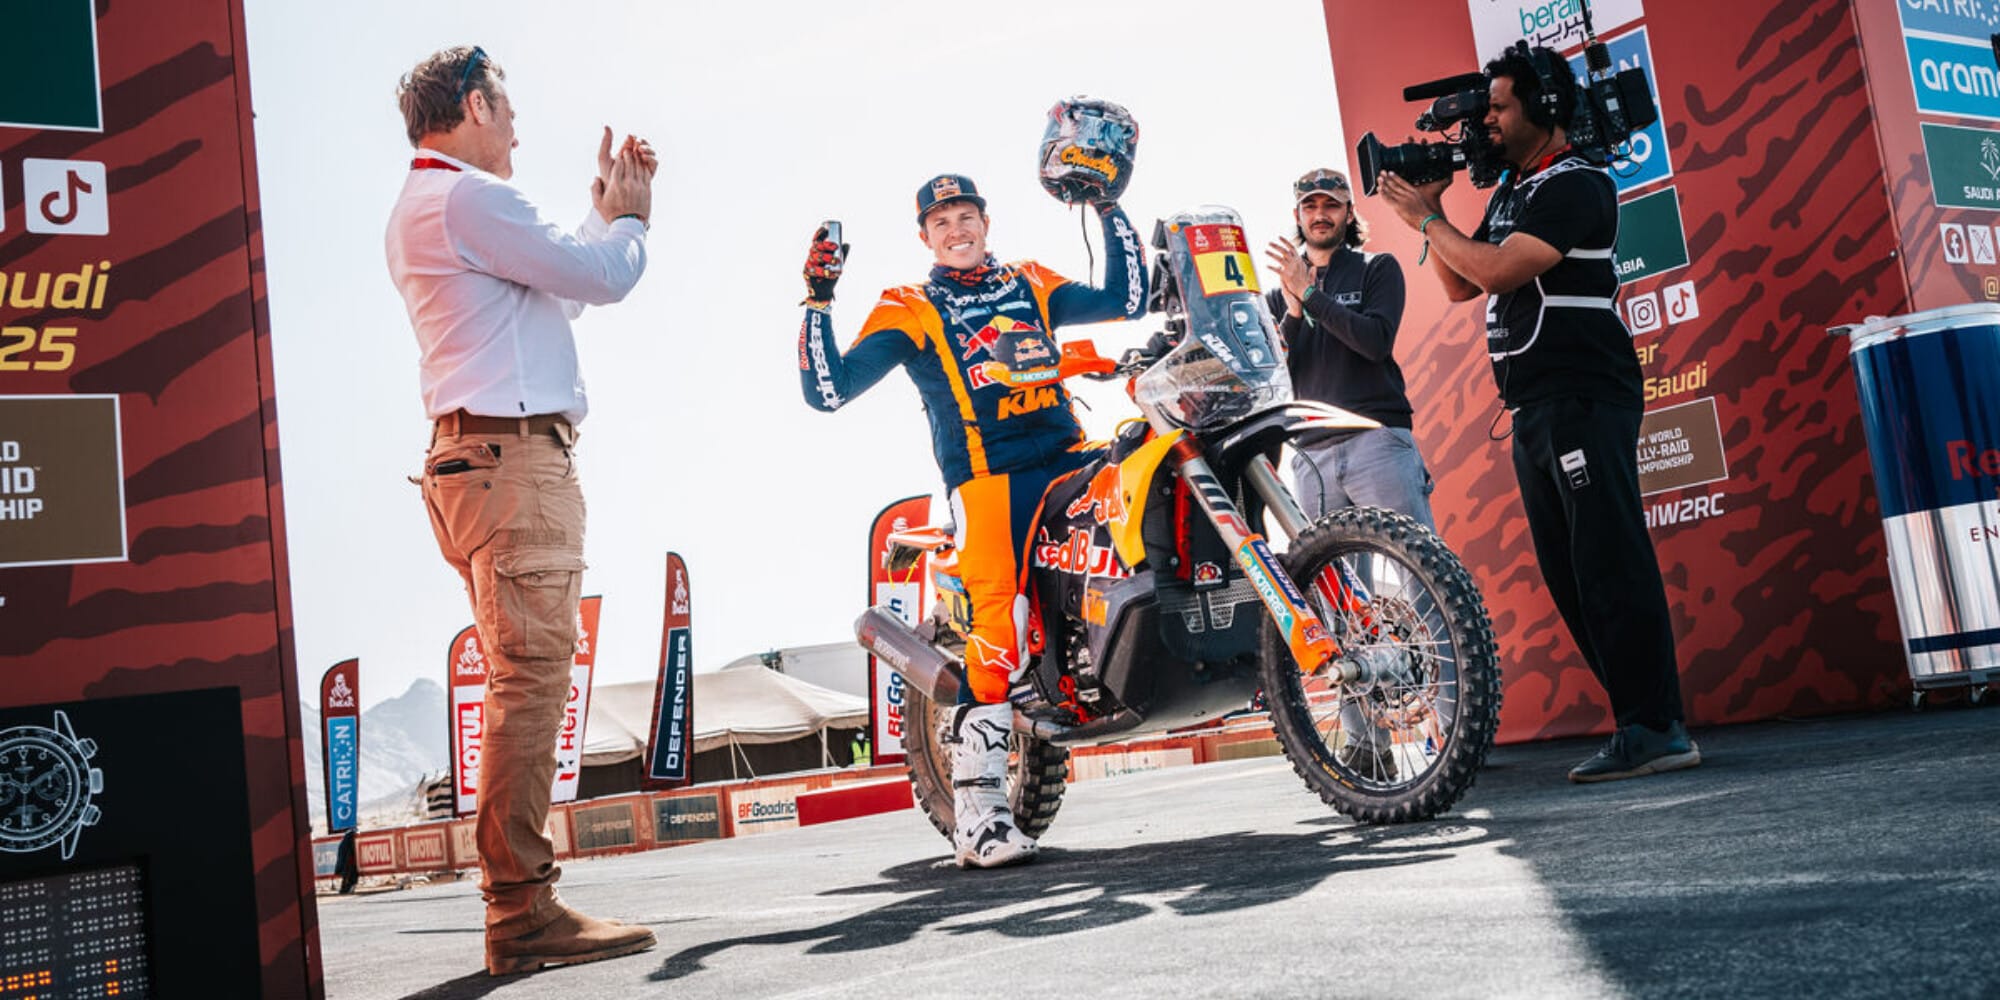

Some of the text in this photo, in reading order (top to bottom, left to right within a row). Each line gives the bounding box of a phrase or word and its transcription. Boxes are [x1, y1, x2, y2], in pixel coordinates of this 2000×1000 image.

[1921, 58, 2000, 98] aram
[1225, 254, 1244, 287] 4
[1643, 361, 1708, 401] Saudi
[997, 387, 1060, 420] KTM
[1648, 427, 1683, 444] WORLD
[1249, 565, 1289, 622] MOTOREX
[666, 635, 687, 770] DEFENDER
[461, 705, 481, 788] MOTUL
[335, 725, 353, 820] CATRION
